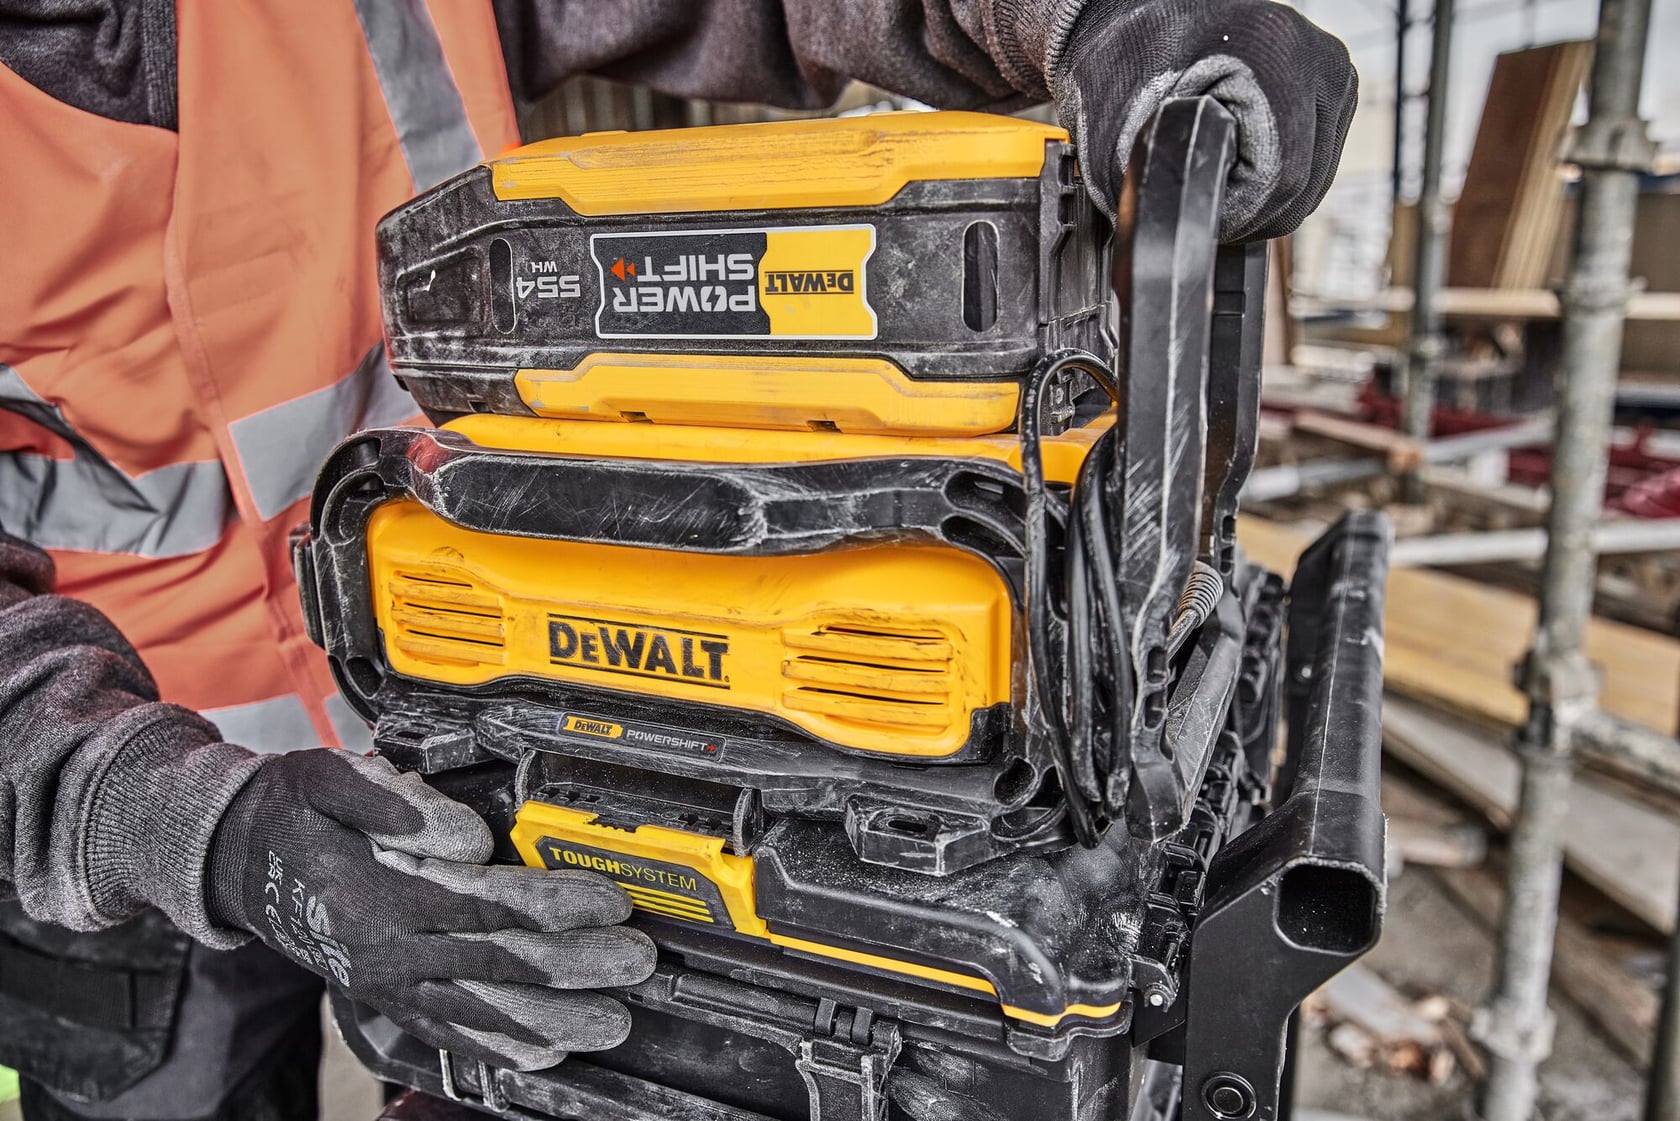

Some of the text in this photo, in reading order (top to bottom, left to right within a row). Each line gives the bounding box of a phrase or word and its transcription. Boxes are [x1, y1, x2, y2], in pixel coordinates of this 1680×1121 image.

[530, 260, 558, 273] WH
[637, 253, 754, 282] SHIFT
[516, 274, 582, 299] 554
[613, 285, 757, 313] POWER
[626, 729, 707, 752] POWERSHIFT
[548, 846, 698, 891] TOUGHSYSTEM
